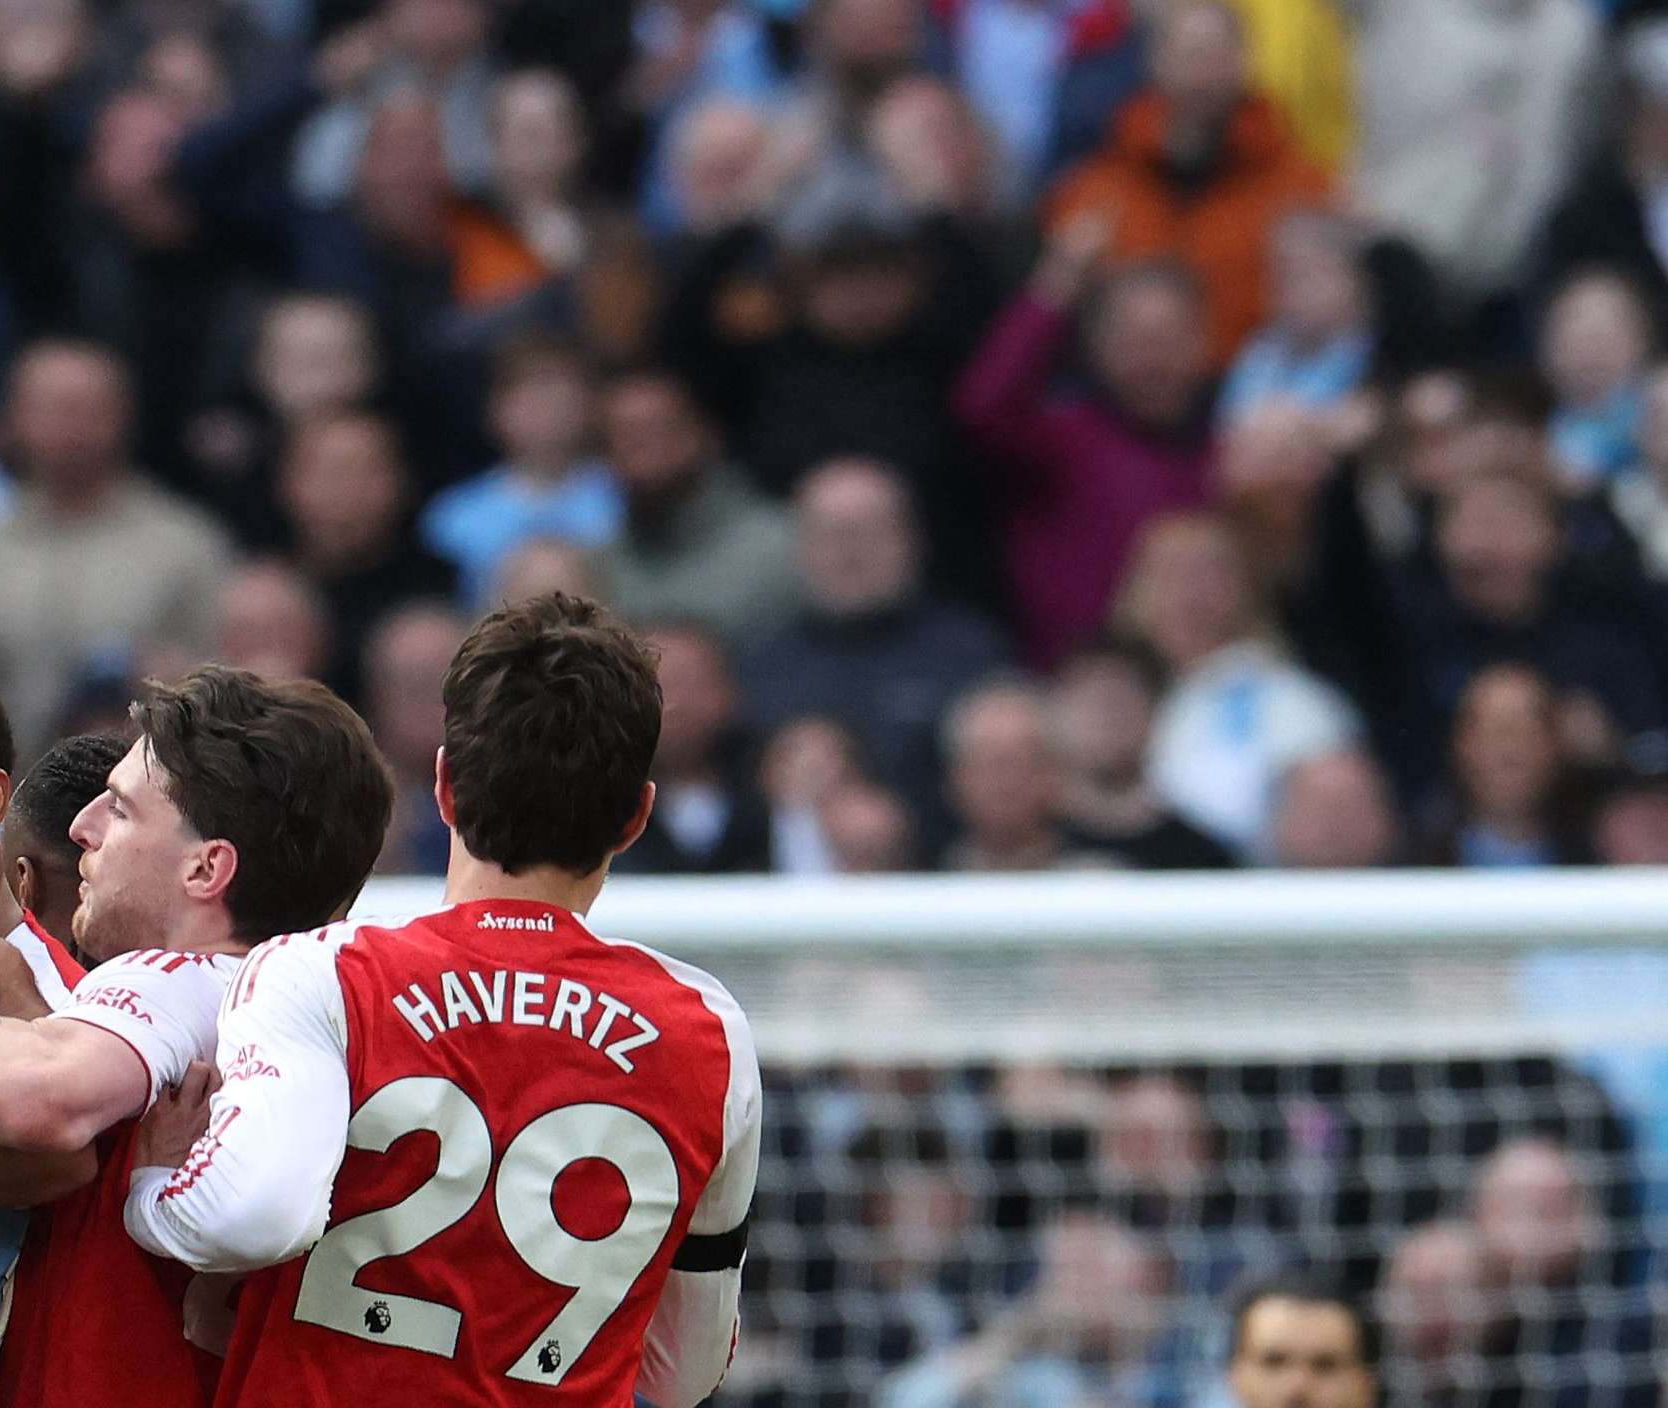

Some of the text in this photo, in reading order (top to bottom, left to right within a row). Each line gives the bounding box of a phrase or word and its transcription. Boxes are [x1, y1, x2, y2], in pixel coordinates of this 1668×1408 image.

[477, 911, 554, 933] Arsenal
[392, 968, 660, 1074] HAVERTZ
[292, 1076, 681, 1386] 29
